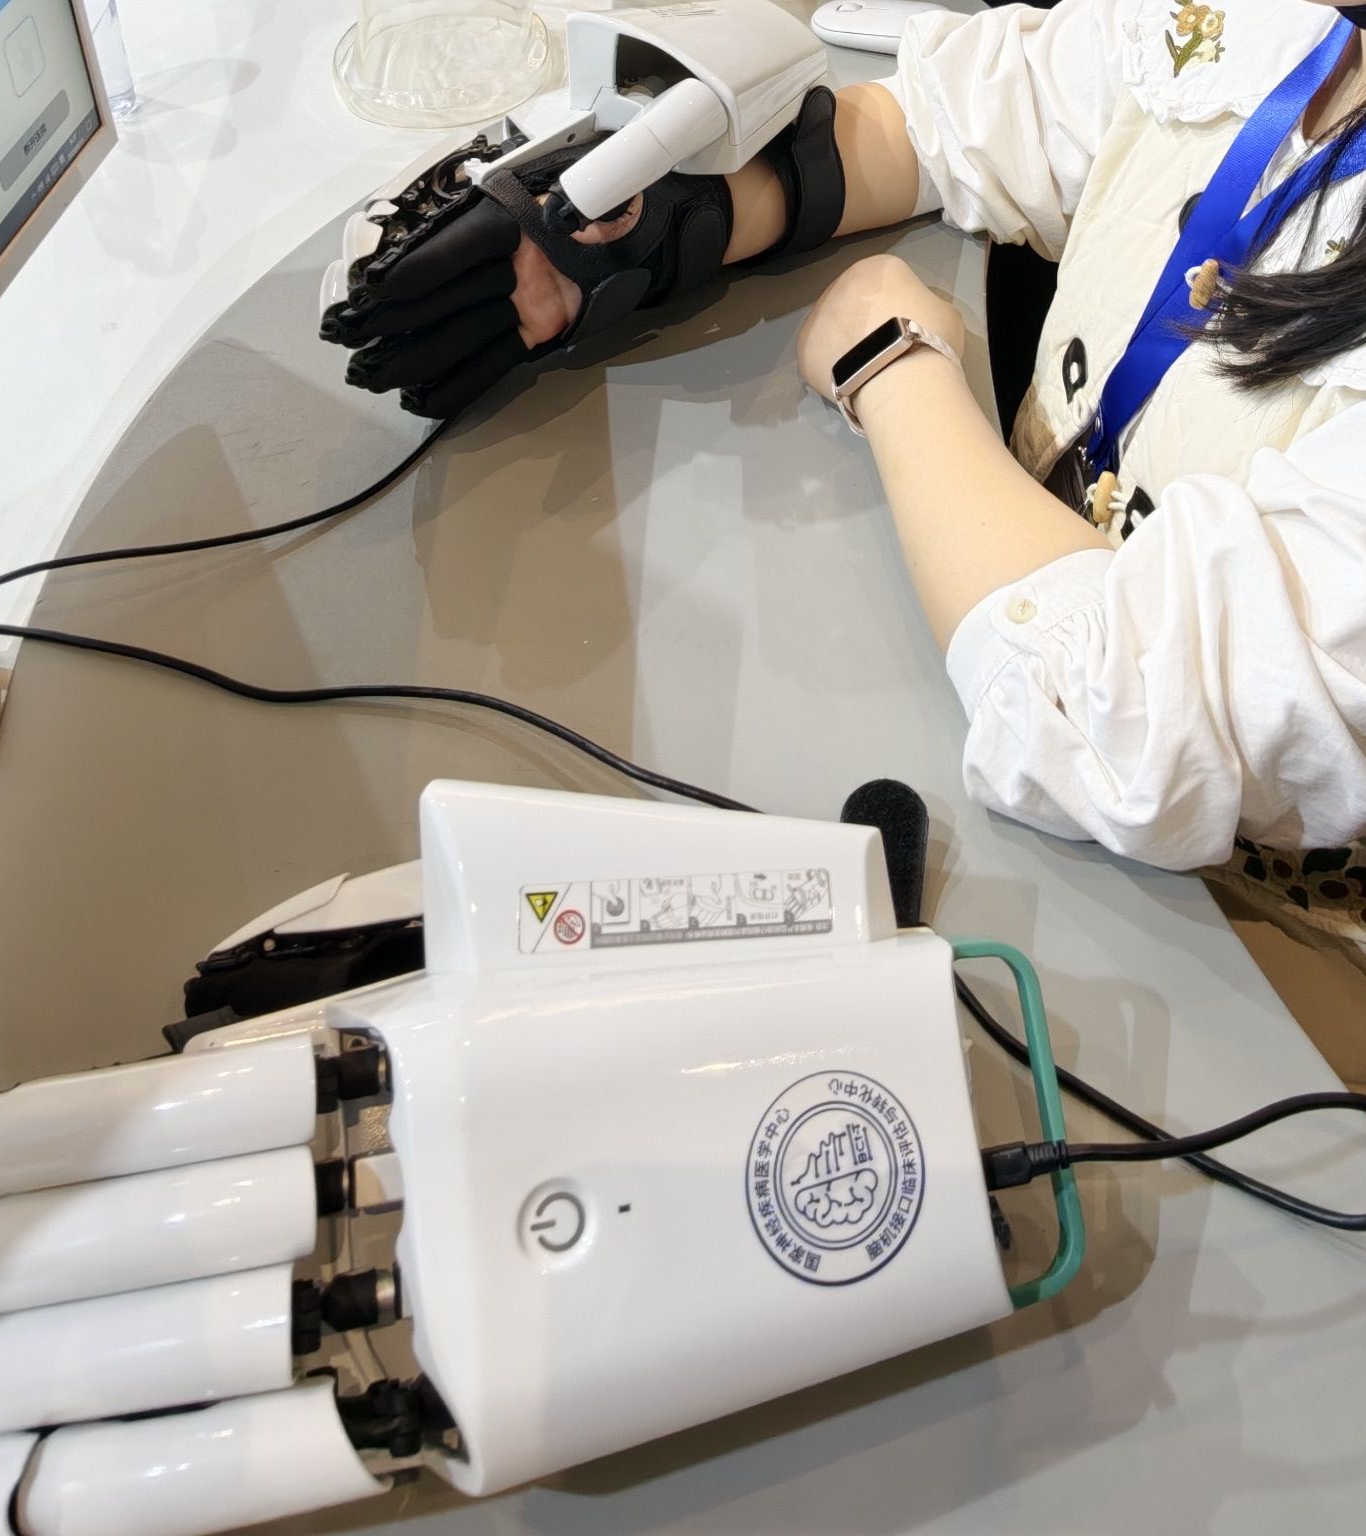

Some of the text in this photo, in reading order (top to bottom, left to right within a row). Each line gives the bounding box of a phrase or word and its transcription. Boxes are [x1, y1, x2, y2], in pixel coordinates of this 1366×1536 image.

[753, 1108, 822, 1273] 国家神经疾病医学中心
